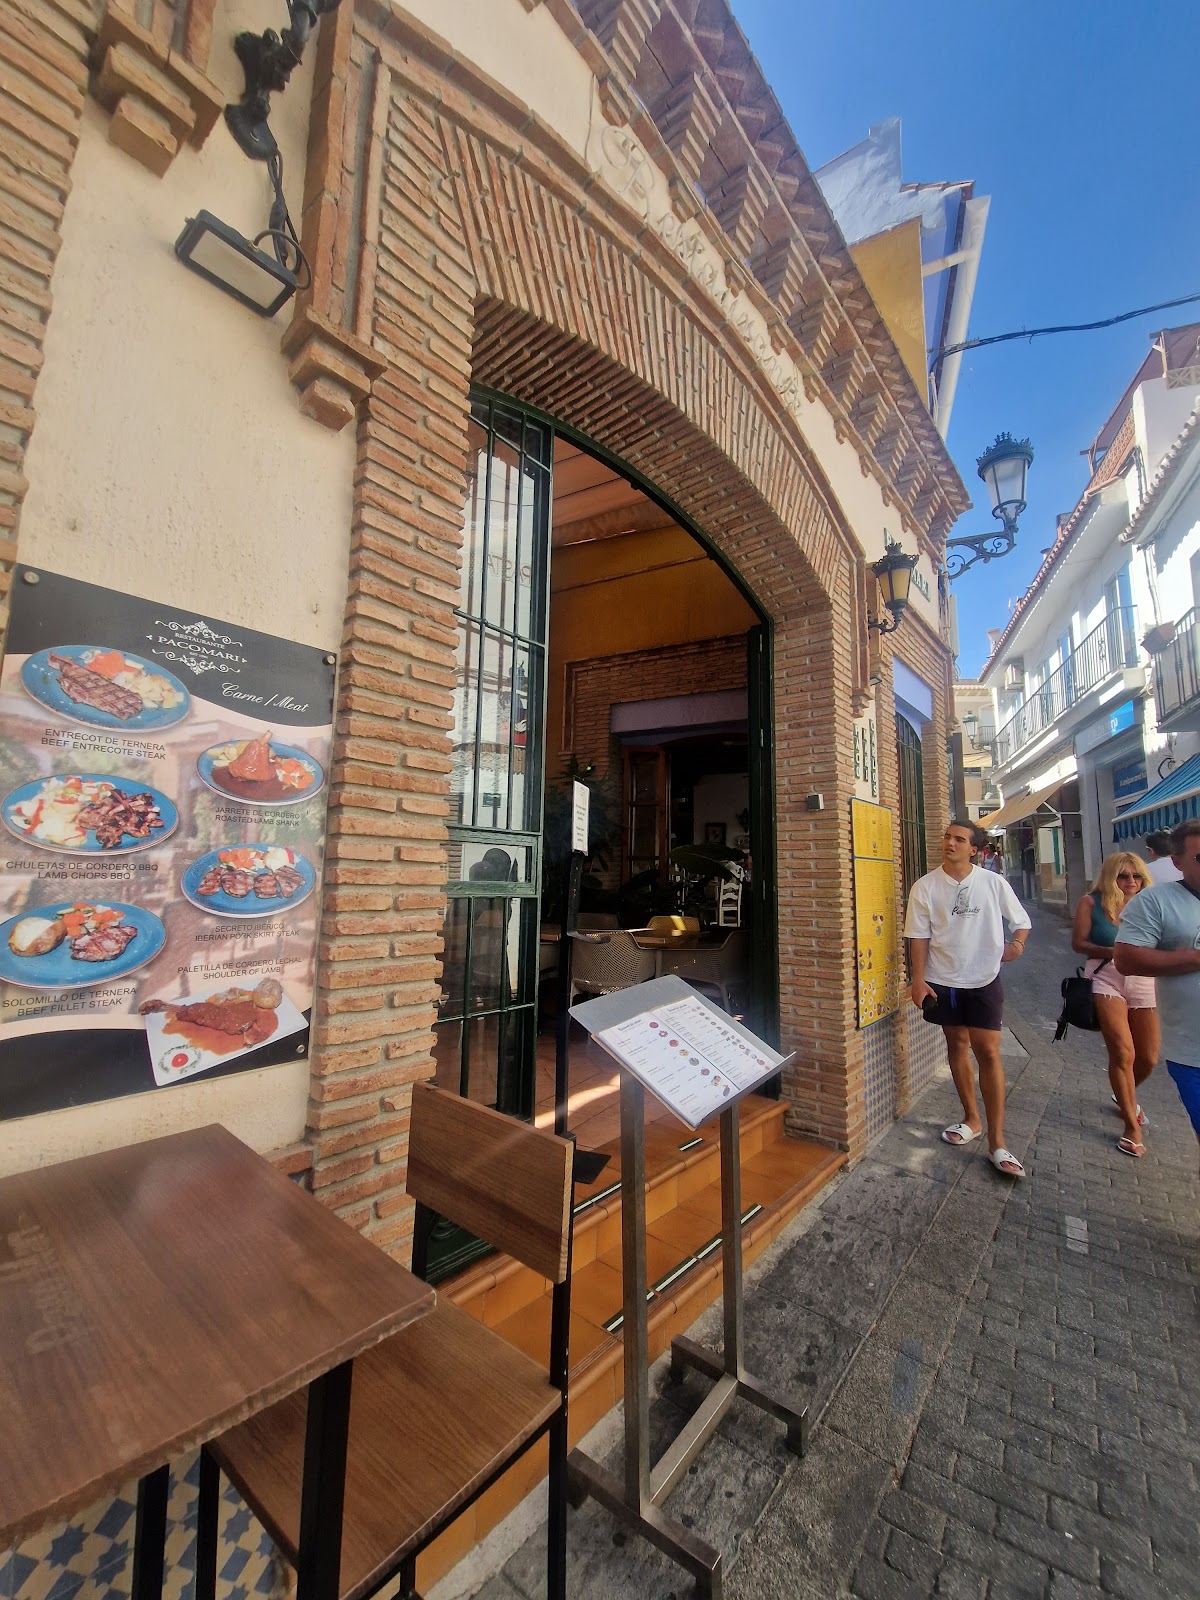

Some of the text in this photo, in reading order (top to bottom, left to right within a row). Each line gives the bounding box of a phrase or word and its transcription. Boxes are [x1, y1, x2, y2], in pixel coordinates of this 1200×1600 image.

[157, 635, 240, 662] PACOMARI
[174, 632, 226, 650] RESTAURANTE
[221, 682, 263, 704] Carne
[273, 696, 309, 713] Meat
[45, 728, 165, 751] ENTRECOT DE TERNERA
[41, 737, 166, 760] BEEF ENTRECOTE STEAK
[215, 807, 250, 815] JARRETE
[264, 810, 300, 819] CORDERO
[215, 815, 253, 824] ROASTED
[6, 861, 159, 872] CHULETAS DE CORDERO BBQ
[37, 871, 131, 880] LAMB CHOPS BBQ
[195, 929, 300, 942] IBERIAN PORK SKIRT STEAK
[215, 924, 253, 933] SECRETO
[177, 957, 302, 974] PALETILLA DE CORDERO LECHAL
[203, 966, 281, 980] SHOULDER OF LAMB
[2, 987, 137, 1008] SOLOMILLO DE TERNERA
[17, 998, 123, 1017] BEEF FILLET STEAK
